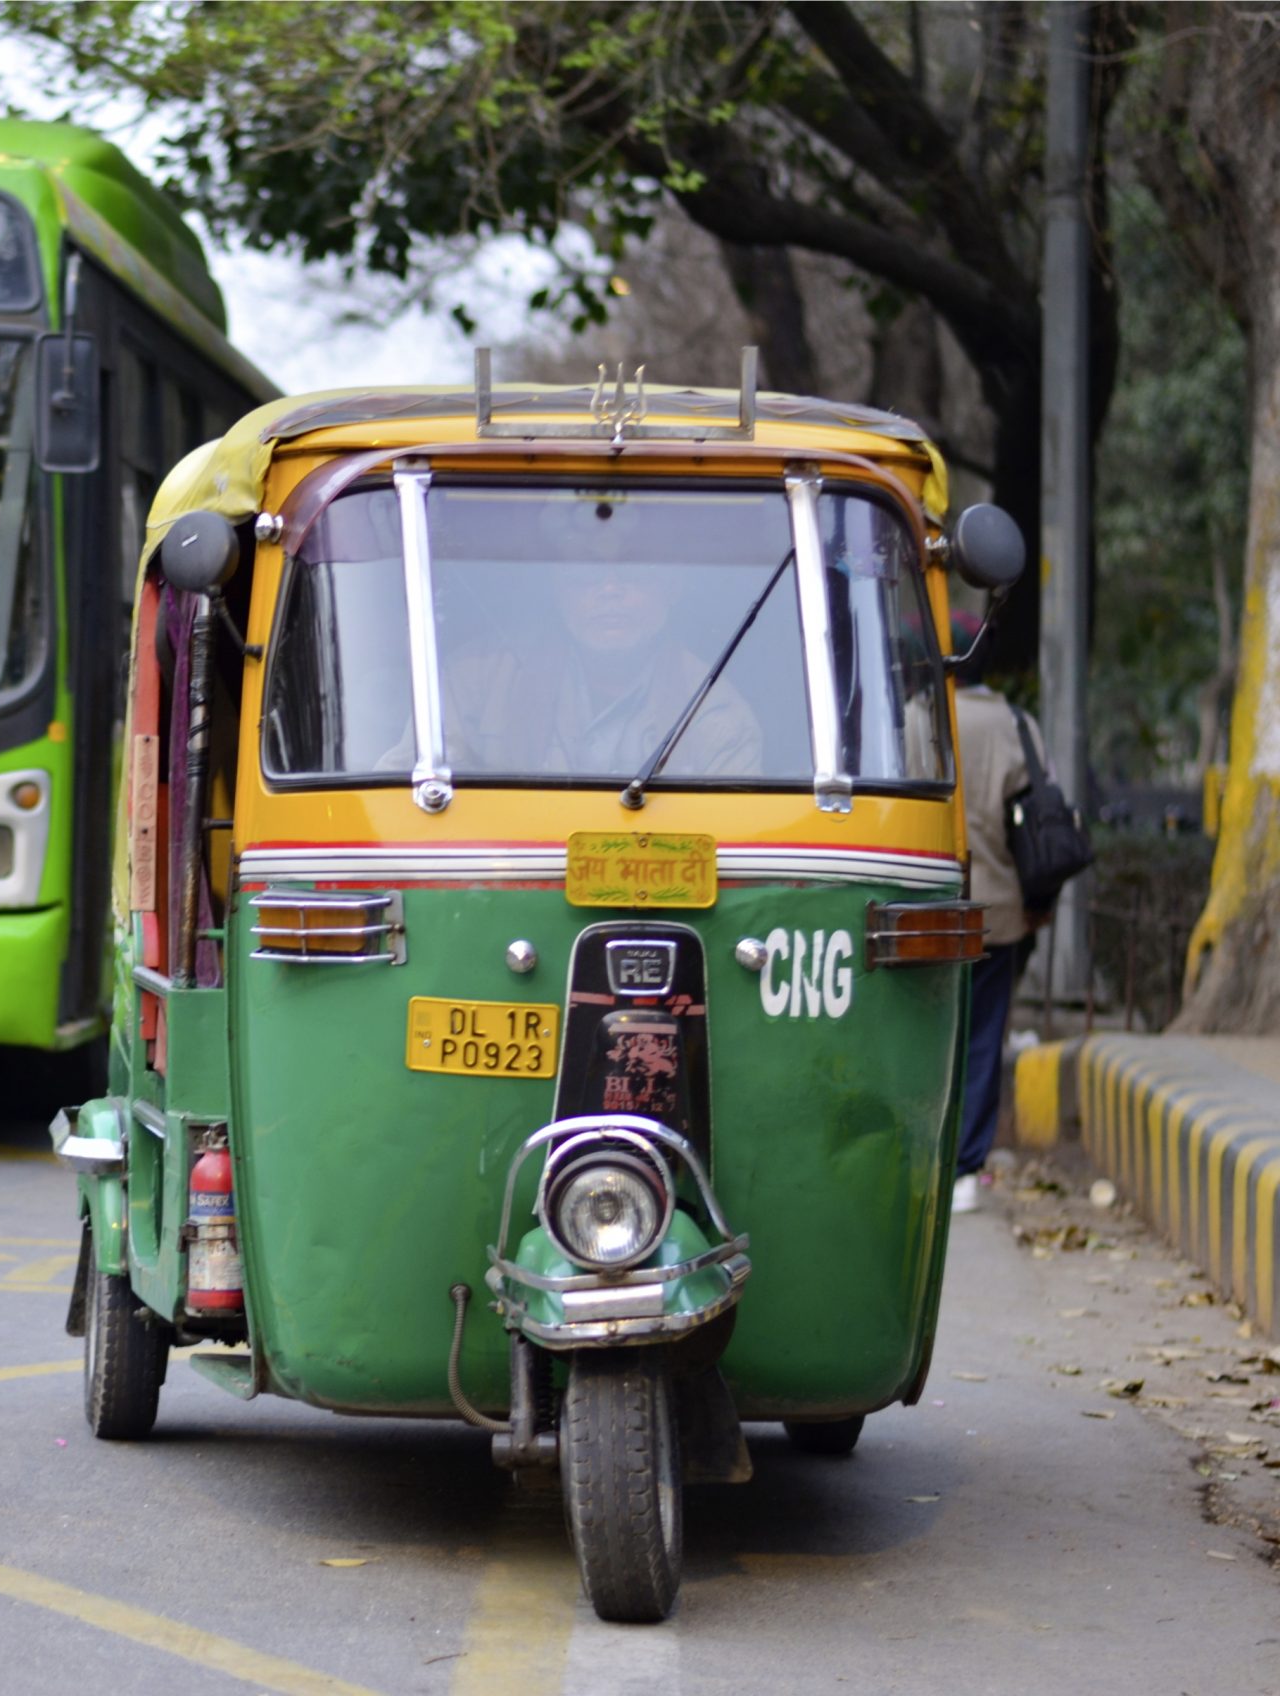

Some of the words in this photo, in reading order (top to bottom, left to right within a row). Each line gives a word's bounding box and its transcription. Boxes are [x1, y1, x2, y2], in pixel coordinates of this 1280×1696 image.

[620, 959, 662, 983] RE
[760, 927, 853, 1018] CNG
[449, 1007, 487, 1038] DL
[506, 1010, 542, 1041] 1R
[440, 1038, 543, 1072] P0923
